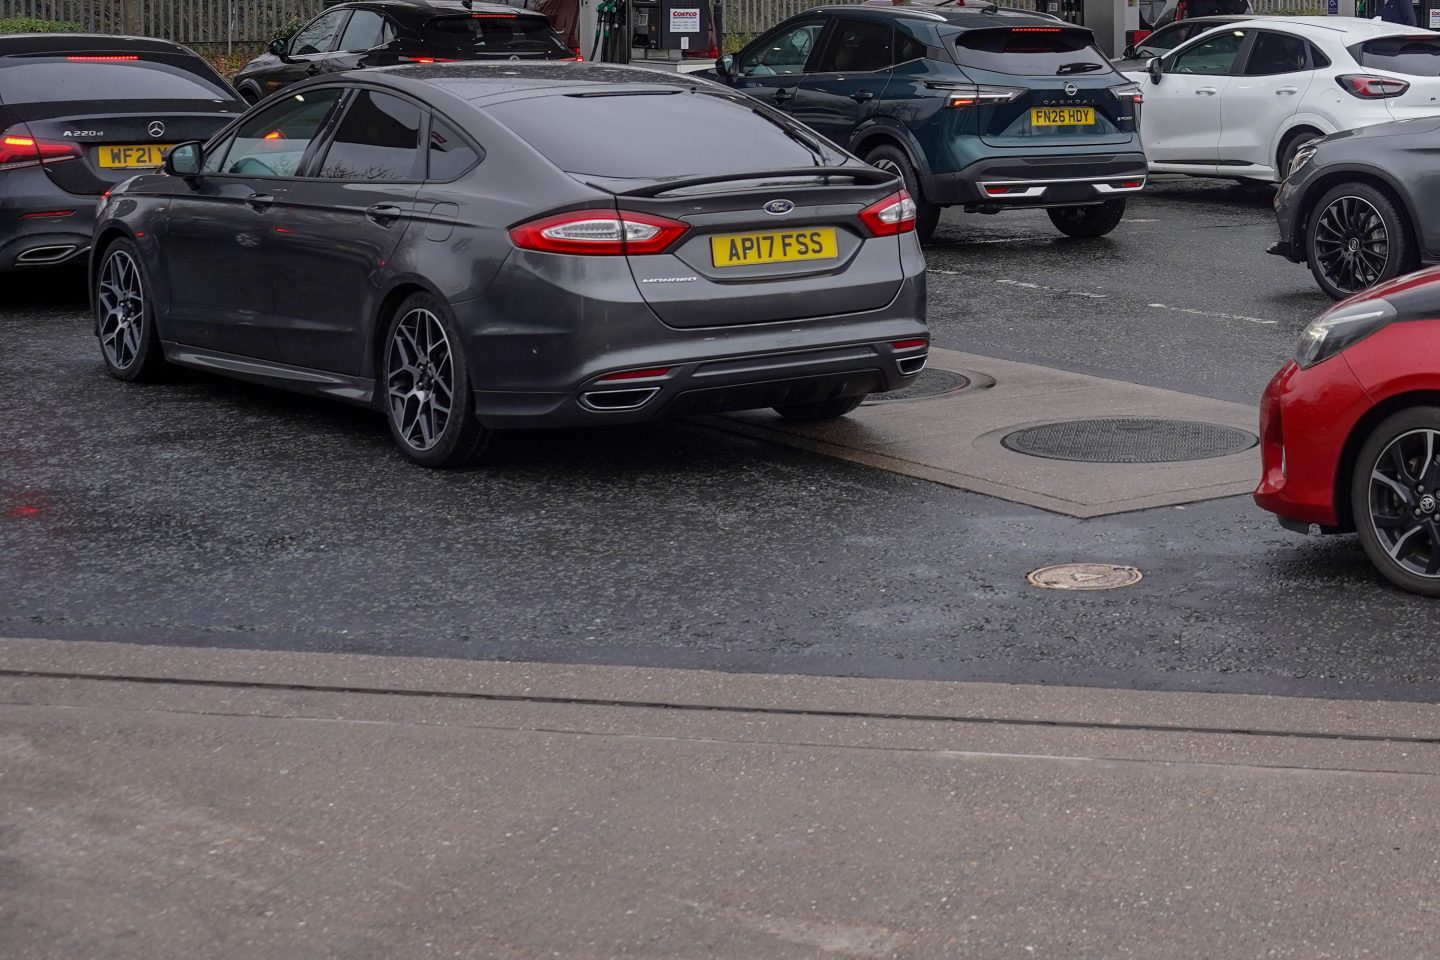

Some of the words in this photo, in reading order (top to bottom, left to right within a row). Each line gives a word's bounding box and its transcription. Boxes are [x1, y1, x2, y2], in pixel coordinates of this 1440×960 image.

[1036, 109, 1066, 123] FN26
[1068, 109, 1089, 122] HDY
[110, 147, 152, 164] WF21
[728, 235, 775, 261] AP17
[781, 232, 823, 257] FSS
